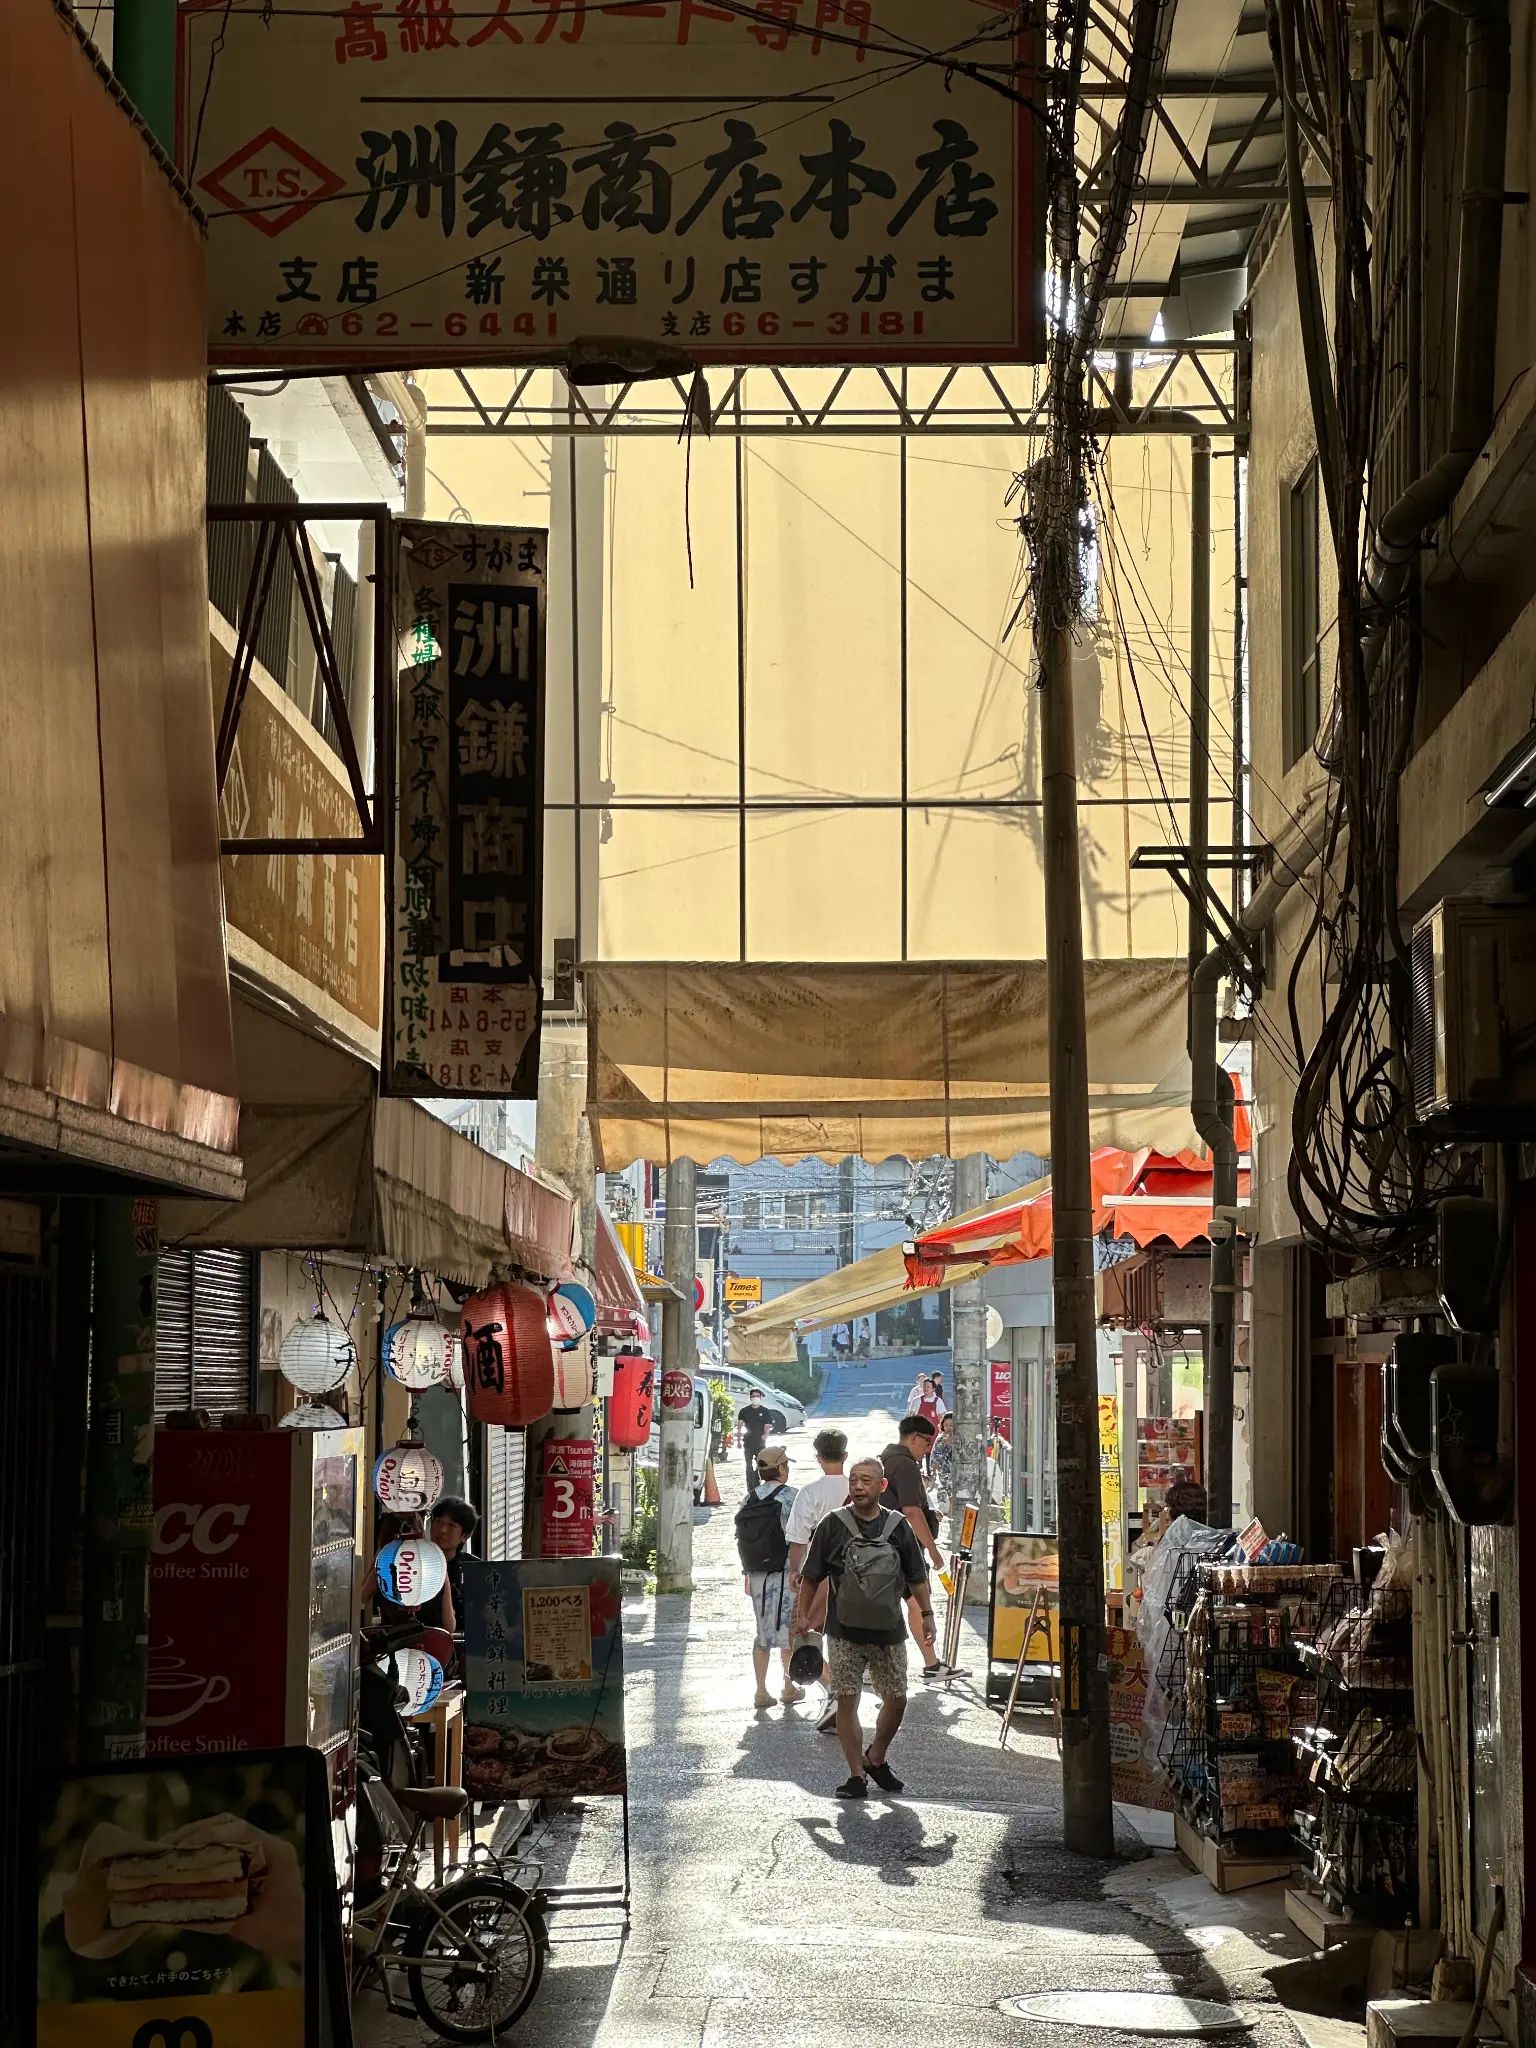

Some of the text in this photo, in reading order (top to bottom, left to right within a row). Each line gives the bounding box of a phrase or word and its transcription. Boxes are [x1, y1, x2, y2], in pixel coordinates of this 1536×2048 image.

[243, 168, 308, 198] T.S.
[354, 118, 999, 240] 洲鎌商店本店
[276, 255, 379, 303] 支店
[222, 310, 282, 337] 本店
[661, 310, 711, 337] 支店
[453, 534, 542, 575] すがま
[729, 1282, 757, 1291] Times
[439, 1333, 454, 1377] Orion
[464, 1319, 504, 1395] 酒
[663, 1382, 690, 1398] 消火栓
[567, 1445, 592, 1455] Tsunami
[379, 1458, 397, 1501] Orion
[551, 1480, 575, 1519] 3
[200, 1562, 250, 1579] Smile
[398, 1551, 417, 1594] Orion
[485, 1570, 508, 1715] 中華海鮮料理
[195, 1736, 248, 1753] Smile
[106, 1967, 232, 1988] できたて、片手のごちそう
